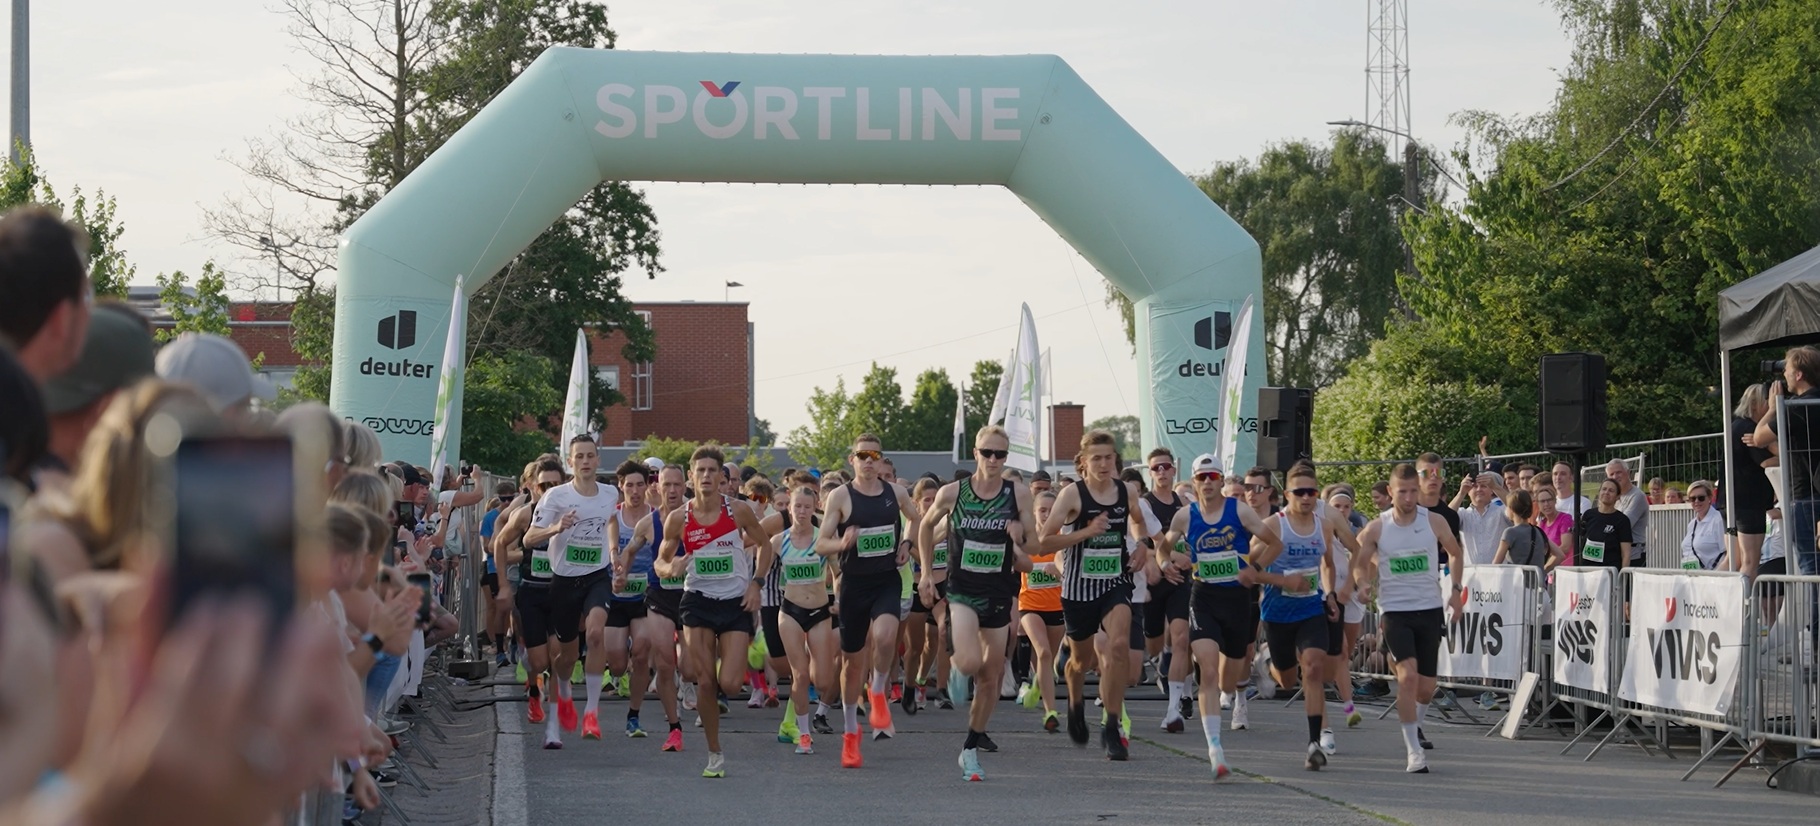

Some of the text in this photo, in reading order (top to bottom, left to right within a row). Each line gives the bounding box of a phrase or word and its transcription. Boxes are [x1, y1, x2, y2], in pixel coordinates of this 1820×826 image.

[593, 81, 1021, 141] SPORTLINE
[360, 356, 434, 379] deuter
[1178, 359, 1248, 378] deu
[345, 416, 434, 436] OWA
[863, 536, 891, 550] 3003
[572, 549, 597, 562] 3012
[968, 552, 998, 566] 3002
[536, 560, 553, 571] 30
[699, 559, 729, 572] 3005
[790, 566, 815, 578] 3001
[1088, 559, 1117, 572] 3004
[1203, 562, 1234, 577] 3008
[1394, 558, 1424, 572] 3030
